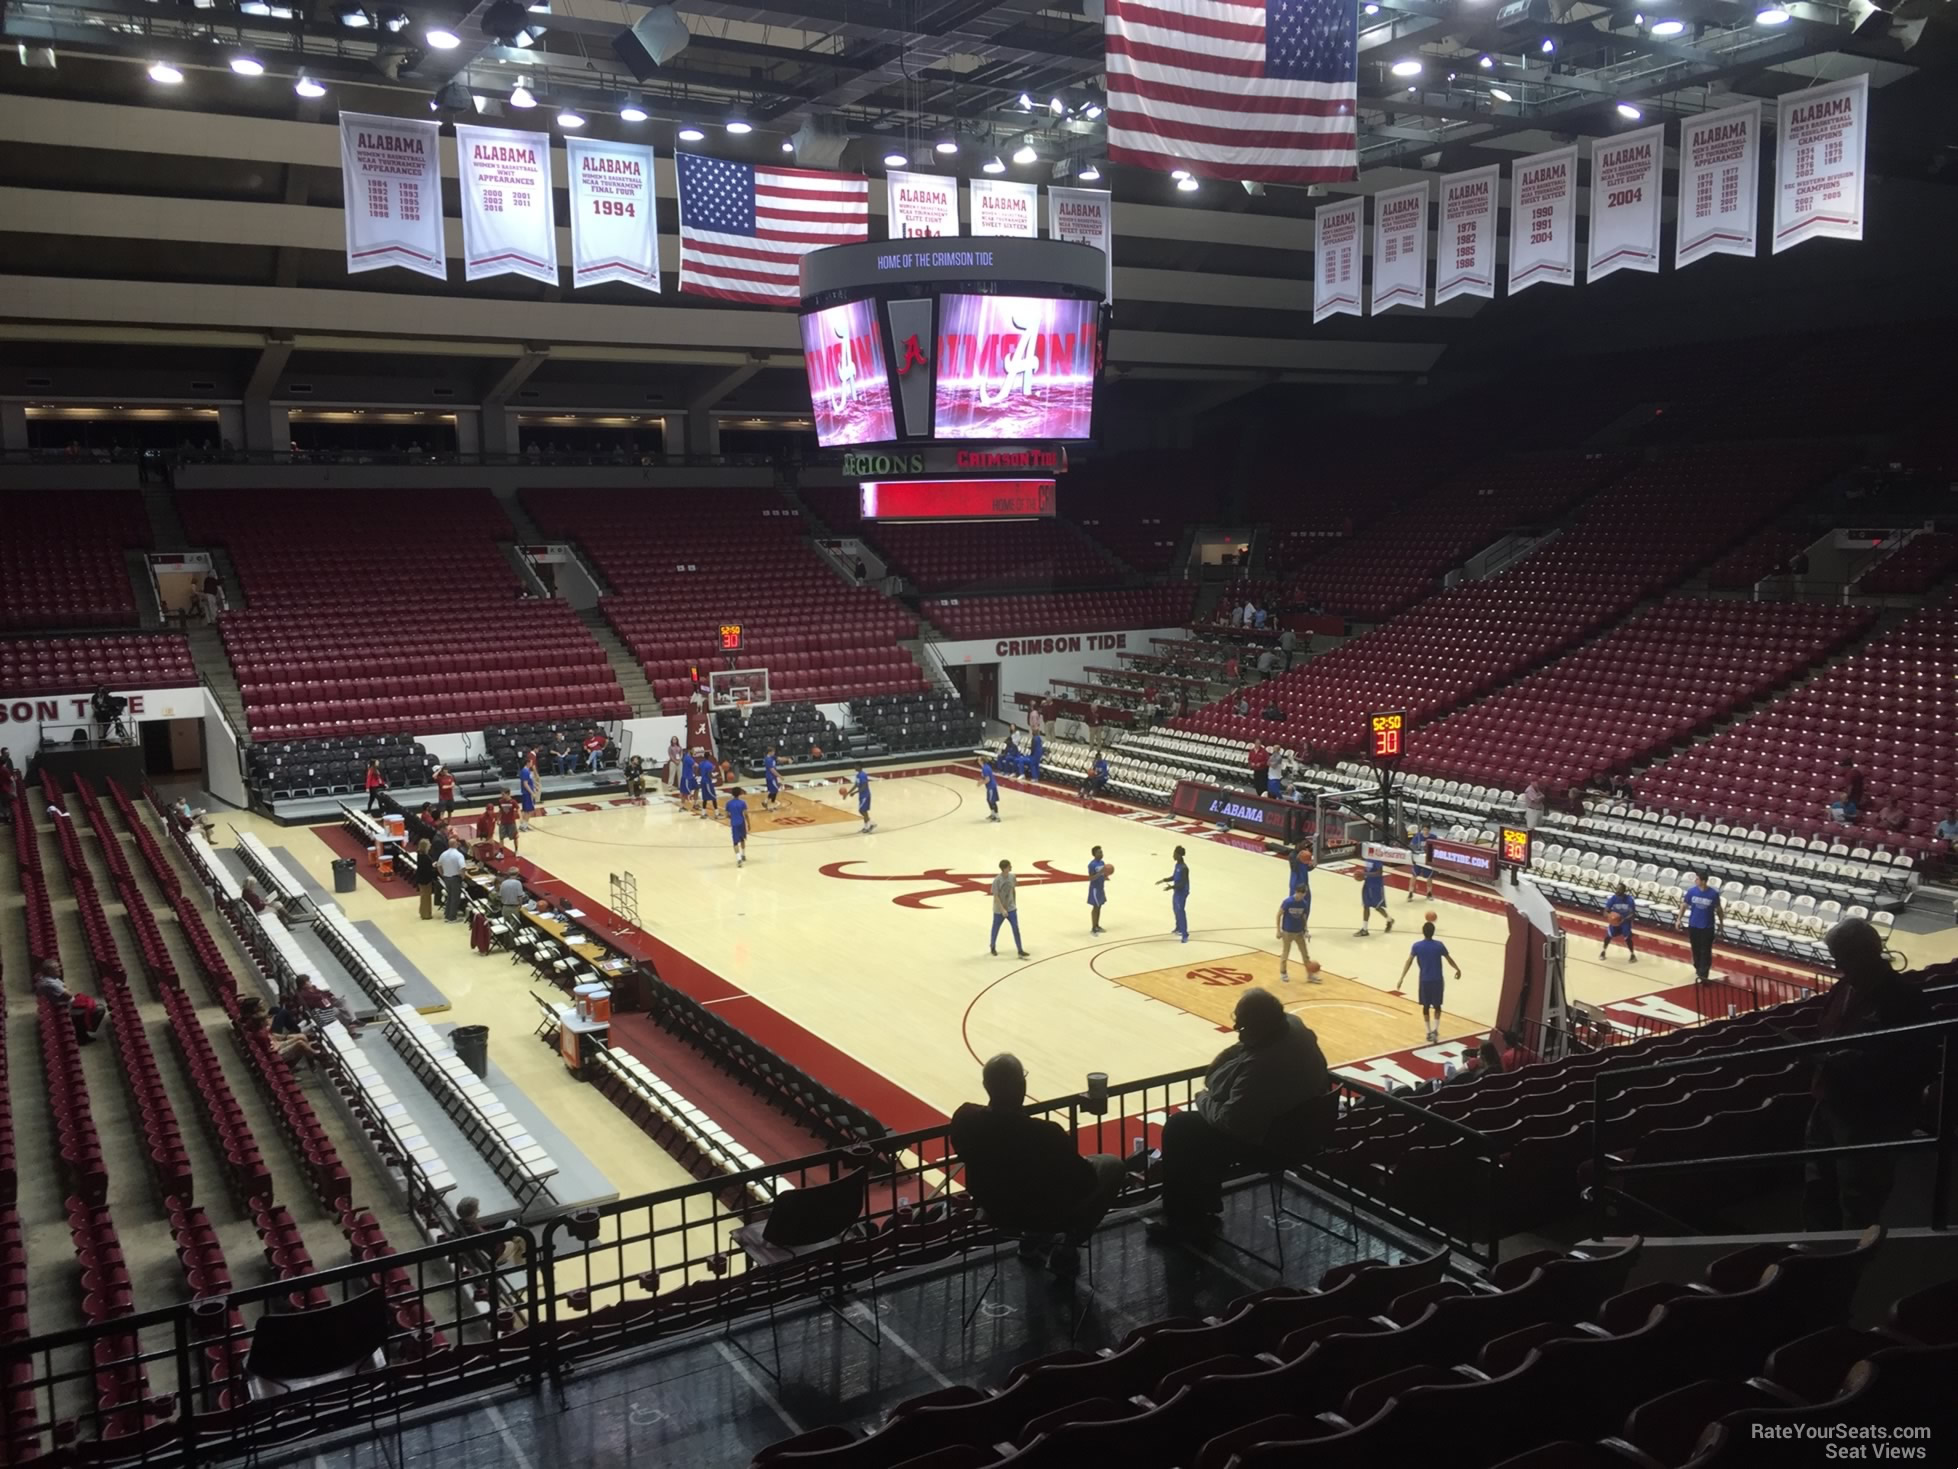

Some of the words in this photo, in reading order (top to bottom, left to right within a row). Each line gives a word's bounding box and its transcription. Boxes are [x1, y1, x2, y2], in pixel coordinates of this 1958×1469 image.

[1791, 96, 1852, 126] ALABAMA
[1811, 114, 1852, 128] BASKETBALL
[1830, 120, 1854, 131] SEASON
[1692, 121, 1746, 148] ALABAMA
[1798, 130, 1842, 146] CHAMPIONS
[358, 132, 424, 154] ALABAMA
[1706, 144, 1744, 158] TOURNAMENT
[1710, 138, 1747, 150] BASKETBALL
[474, 144, 536, 164] ALABAMA
[1602, 144, 1651, 168] ALABAMA
[1694, 151, 1743, 168] APPEARANCES
[362, 164, 422, 176] APPEARANCES
[378, 159, 426, 169] TOURNAMENT
[582, 156, 641, 176] ALABAMA
[1616, 166, 1652, 178] TOURNAMENT
[478, 174, 534, 186] APPEARANCES
[1522, 164, 1566, 186] ALABAMA
[1608, 177, 1624, 187] ELITE
[1626, 172, 1646, 183] EIGHT
[1796, 176, 1826, 188] WESTERN
[1827, 171, 1854, 182] DIVISION
[582, 178, 598, 186] NCAA
[600, 180, 642, 190] TOURNAMENT
[591, 185, 614, 194] FINAL
[616, 188, 634, 196] FOUR
[1448, 182, 1488, 201] ALABAMA
[1796, 180, 1840, 195] CHAMPIONS
[900, 188, 947, 206] ALABAMA
[982, 196, 1026, 212] ALABAMA
[1520, 196, 1541, 206] SWEET
[1542, 190, 1566, 200] SIXTEEN
[1608, 187, 1642, 208] 2004
[593, 200, 635, 217] 1994
[1060, 202, 1101, 218] ALABAMA
[1382, 197, 1419, 216] ALABAMA
[1448, 212, 1465, 220] SWEET
[1466, 206, 1488, 216] SIXTEEN
[1532, 206, 1554, 220] 1990
[1323, 212, 1356, 230] ALABAMA
[1457, 221, 1476, 234] 1976
[1532, 218, 1552, 232] 1991
[1530, 231, 1552, 245] 2004
[1456, 246, 1476, 258] 1985
[878, 254, 901, 270] HOME
[902, 253, 913, 268] OF
[914, 252, 930, 268] THE
[932, 252, 974, 267] CRIMSON
[975, 252, 994, 266] TIDE
[724, 634, 738, 648] 30
[996, 636, 1081, 657] CRIMSON
[1086, 633, 1126, 651] TIDE
[70, 696, 144, 718] TE
[1372, 715, 1402, 731] 52:50
[1376, 730, 1398, 754] 30
[1504, 830, 1527, 844] 52:50
